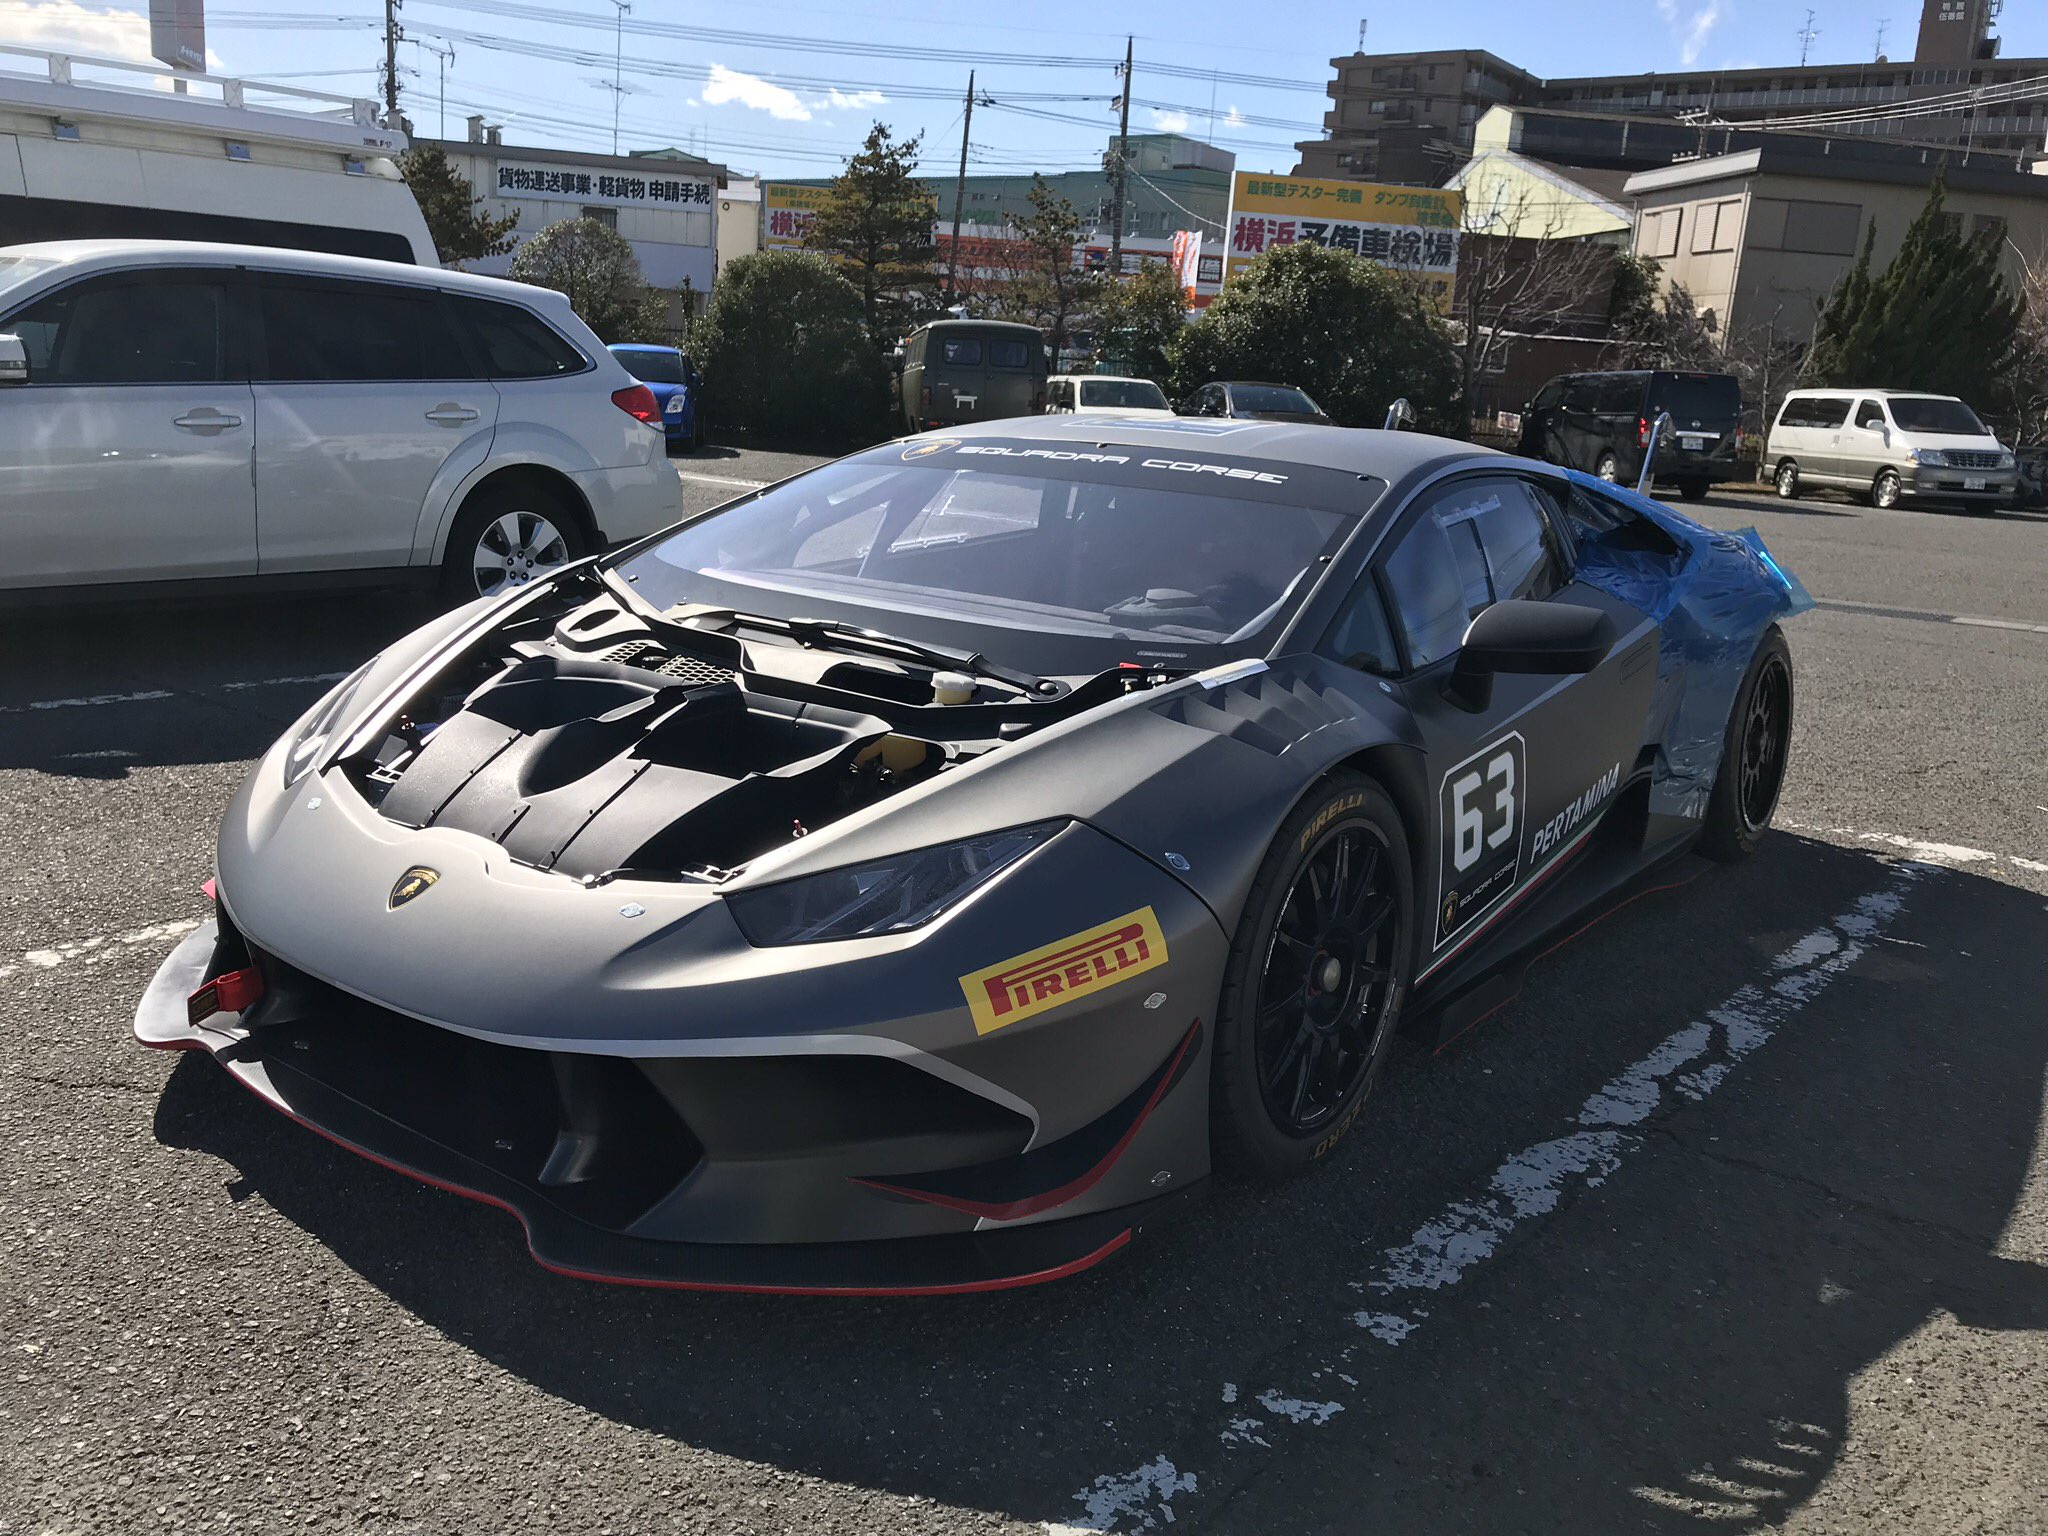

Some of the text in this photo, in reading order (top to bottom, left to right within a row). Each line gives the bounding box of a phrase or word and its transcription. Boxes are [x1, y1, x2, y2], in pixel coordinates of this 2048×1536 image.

[648, 180, 711, 205] 申請手続
[956, 446, 1289, 485] SQUADRA CORSE
[1299, 793, 1363, 853] PIRELLI
[1453, 751, 1515, 873] 63
[1529, 762, 1621, 865] PERTAMINA
[983, 922, 1151, 1017] PIRELLI
